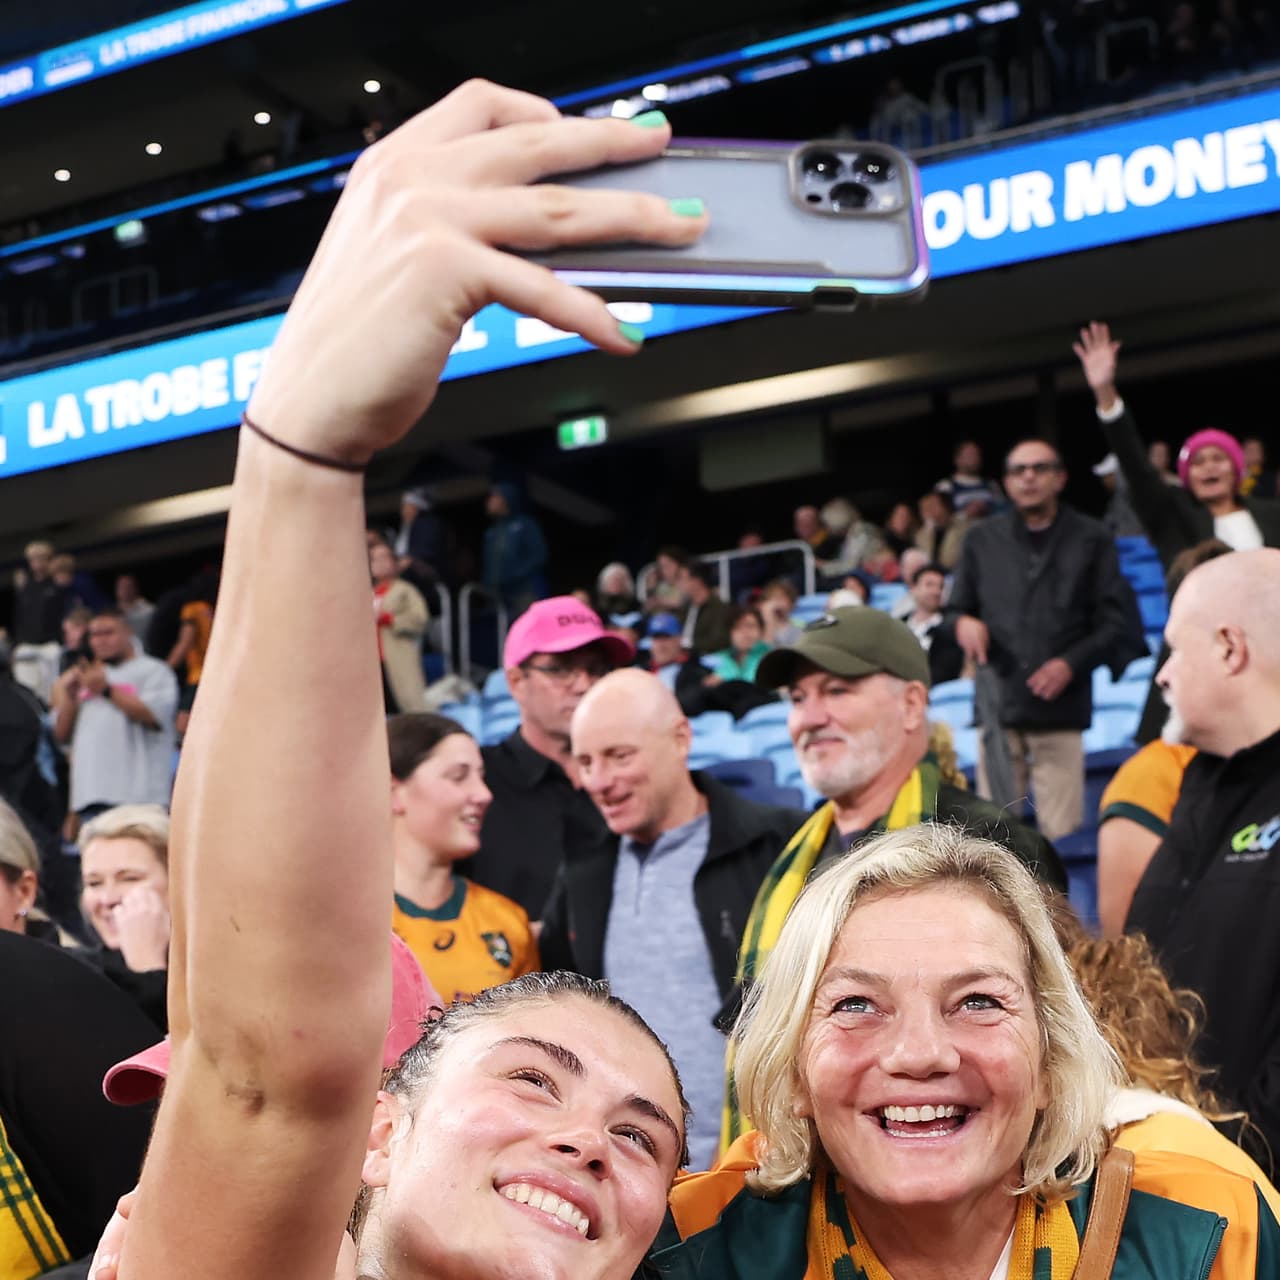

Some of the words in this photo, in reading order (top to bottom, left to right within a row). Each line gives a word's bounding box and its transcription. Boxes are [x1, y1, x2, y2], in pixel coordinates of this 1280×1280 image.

[921, 170, 1055, 250] OUR
[27, 394, 85, 449] LA
[85, 358, 228, 433] TROBE
